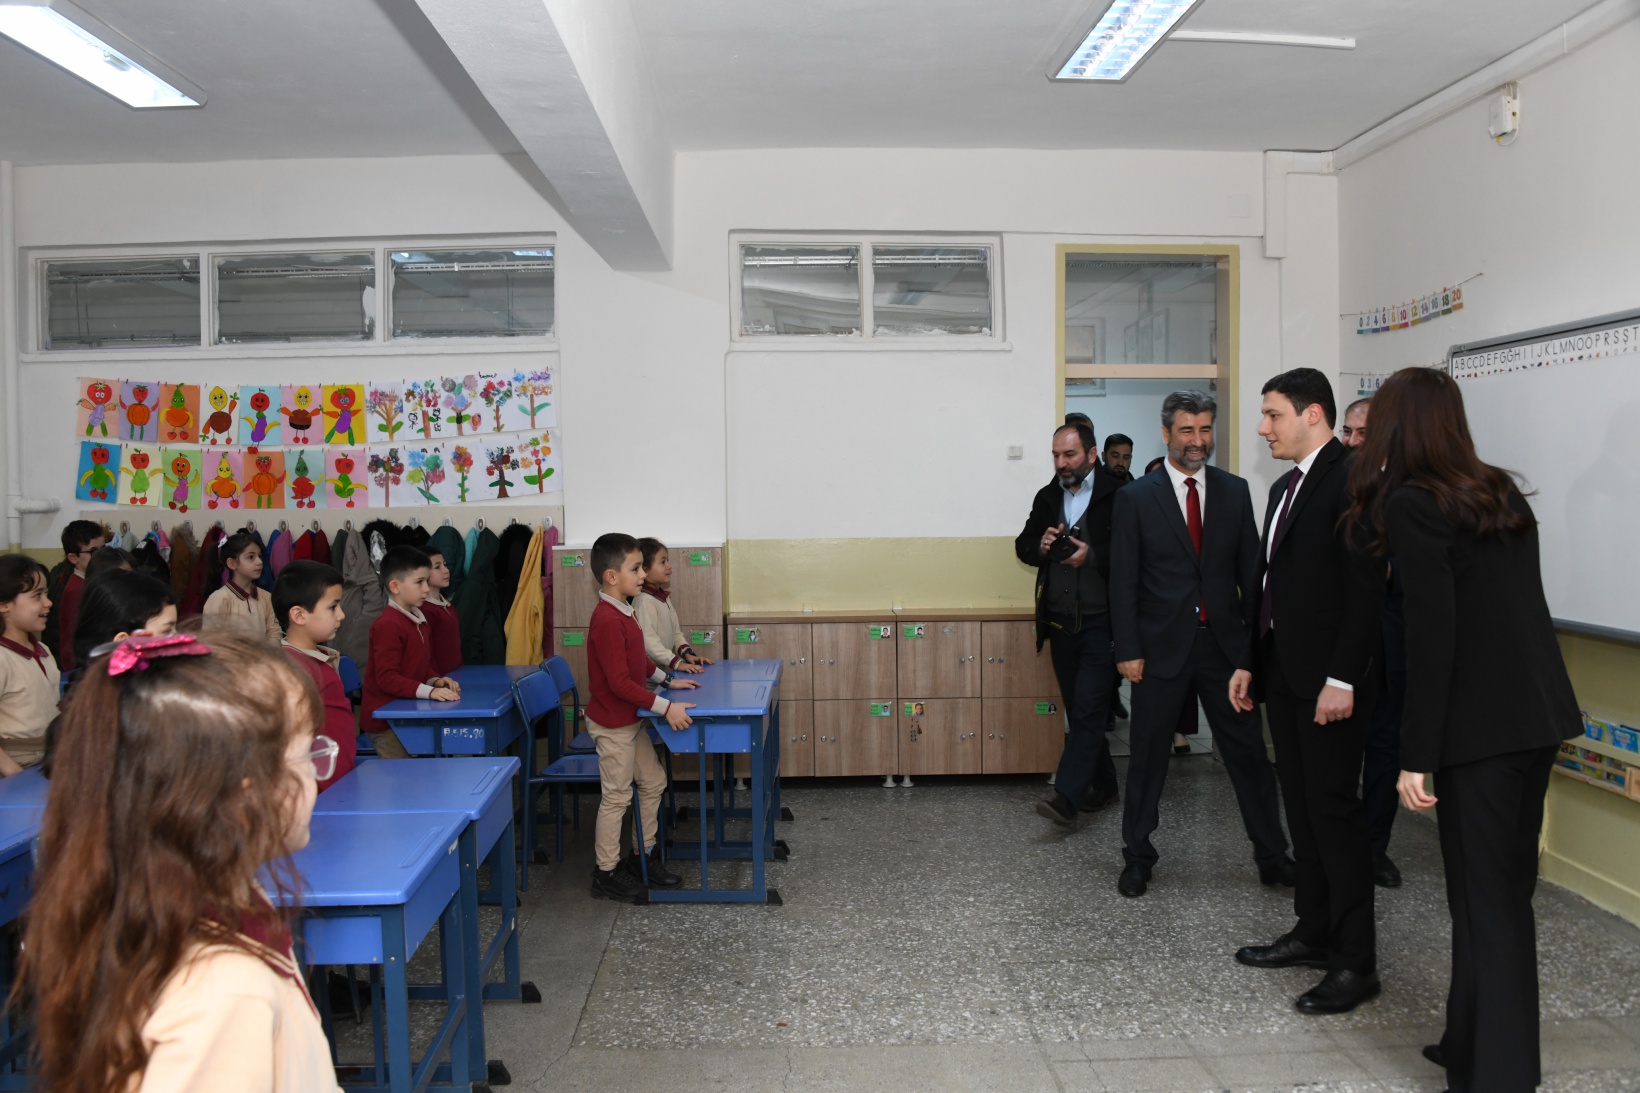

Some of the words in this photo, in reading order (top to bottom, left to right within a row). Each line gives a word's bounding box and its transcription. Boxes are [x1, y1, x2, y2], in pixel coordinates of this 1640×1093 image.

[1359, 317, 1363, 327] 0
[1366, 316, 1370, 326] 2
[1374, 315, 1378, 325] 4
[1382, 313, 1386, 324] 6
[1391, 312, 1396, 322] 8
[1400, 310, 1406, 321] 10
[1411, 305, 1418, 317] 12
[1421, 302, 1428, 314] 14
[1431, 298, 1438, 310] 16
[1442, 294, 1449, 307] 18
[1452, 288, 1461, 302] 20
[1455, 359, 1459, 370] A
[1461, 359, 1464, 370] B
[1467, 357, 1472, 369] C
[1480, 356, 1485, 367] D
[1487, 354, 1491, 366] E
[1494, 353, 1498, 364] F
[1500, 352, 1506, 363] G
[1514, 349, 1520, 361] H
[1537, 345, 1542, 357] J
[1545, 343, 1550, 356] K
[1553, 342, 1557, 354] L
[1560, 340, 1568, 354] M
[1568, 339, 1575, 352] N
[1577, 337, 1584, 350] O
[1595, 334, 1600, 347] P
[1604, 333, 1609, 346] R
[1614, 331, 1619, 344] S
[1632, 326, 1638, 340] T
[1361, 378, 1364, 388] 0
[1367, 378, 1371, 388] 3
[1376, 378, 1379, 388] 6
